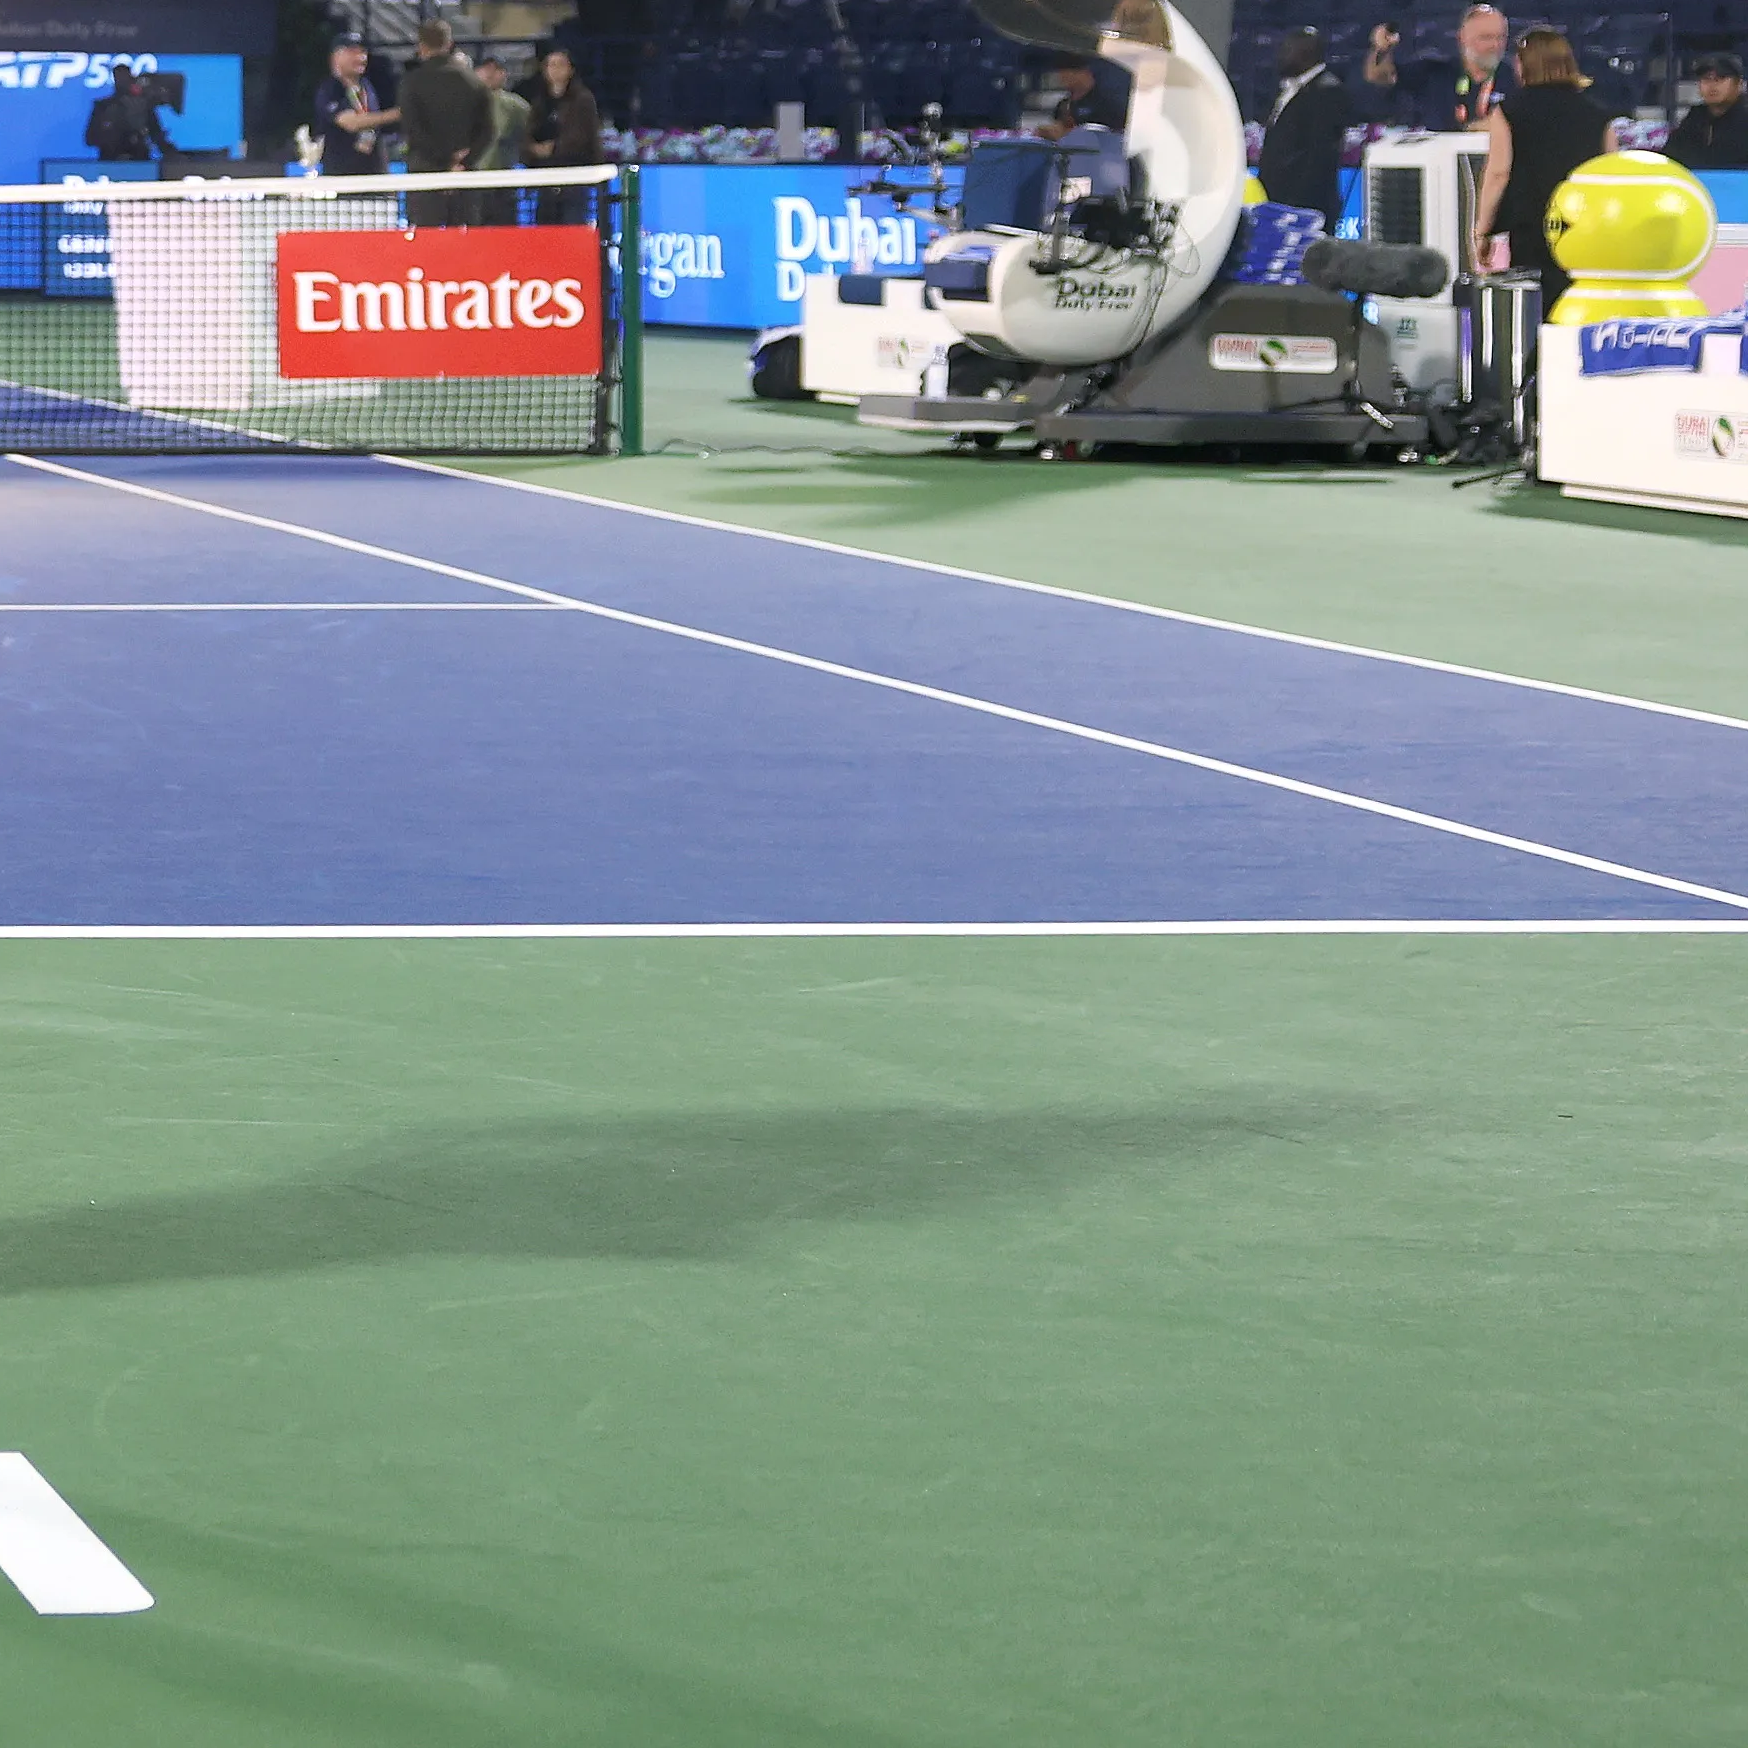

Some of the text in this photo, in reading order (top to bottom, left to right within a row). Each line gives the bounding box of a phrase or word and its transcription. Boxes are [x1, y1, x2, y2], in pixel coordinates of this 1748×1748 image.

[773, 195, 916, 265] Dubai
[292, 267, 585, 333] Emirates
[1057, 276, 1137, 299] Dubai
